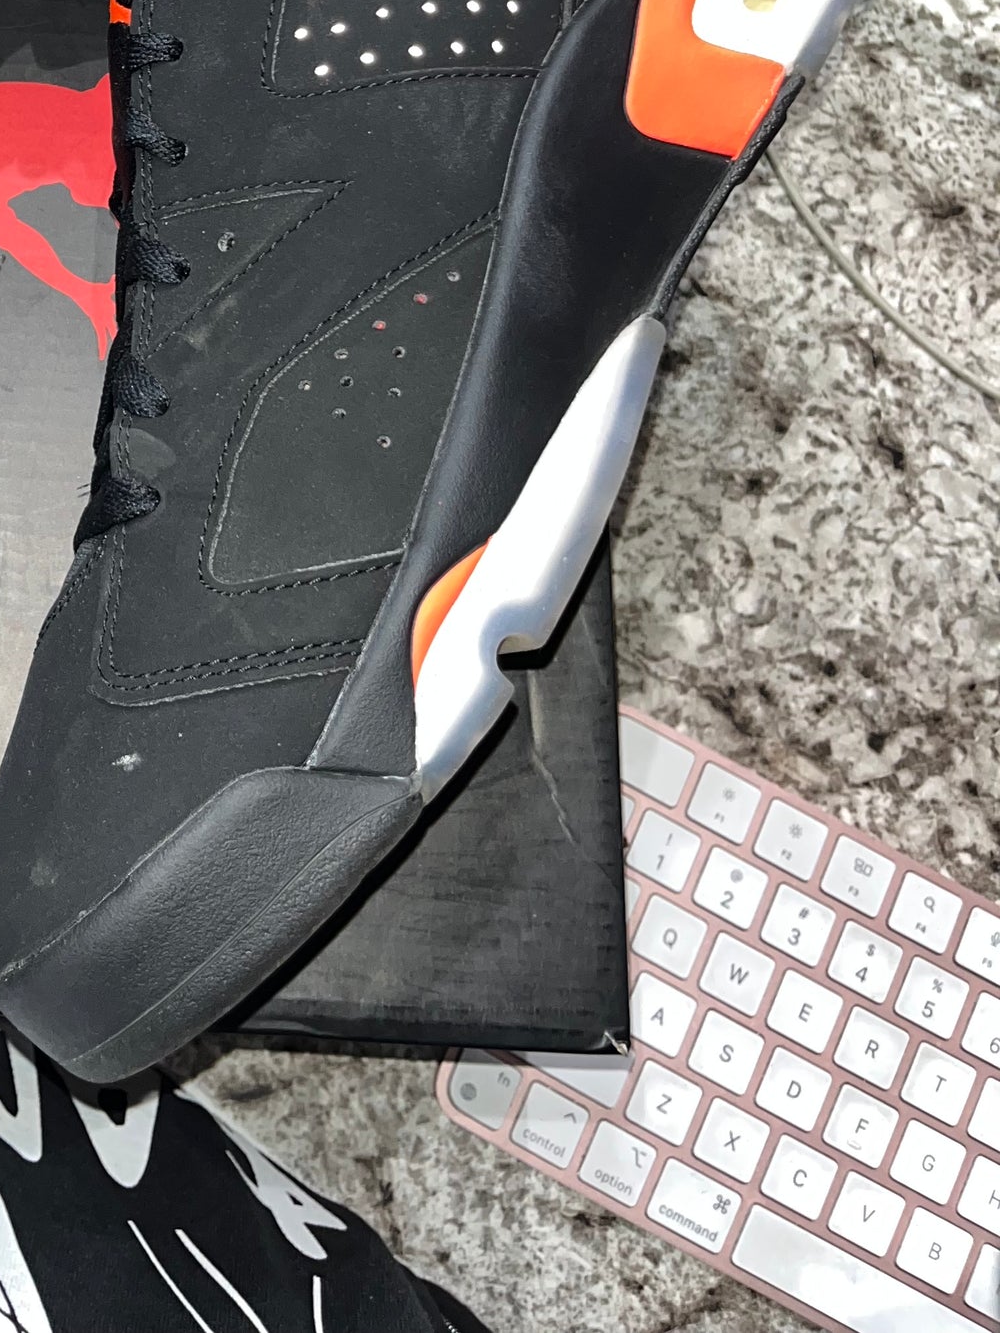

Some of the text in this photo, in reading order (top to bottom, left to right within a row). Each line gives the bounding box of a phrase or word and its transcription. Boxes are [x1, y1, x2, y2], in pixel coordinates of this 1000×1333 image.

[714, 812, 725, 823] F1
[656, 854, 665, 871] 1
[780, 848, 793, 861] F2
[720, 891, 734, 909] 2
[847, 885, 860, 897] F3
[787, 927, 802, 946] 3
[915, 922, 927, 934] F4
[662, 928, 678, 949] Q
[729, 963, 750, 985] W
[855, 966, 868, 983] 4
[650, 1007, 664, 1027] A
[798, 1002, 813, 1023] E
[921, 1000, 936, 1019] 5
[718, 1044, 735, 1063] S
[864, 1038, 880, 1059] R
[989, 1037, 1000, 1054] 6
[497, 1072, 511, 1088] fn
[786, 1079, 802, 1099] D
[935, 1074, 947, 1093] T
[656, 1093, 673, 1115] Z
[855, 1118, 869, 1136] F
[521, 1126, 567, 1159] control
[723, 1130, 741, 1152] X
[921, 1154, 936, 1172] G
[593, 1165, 634, 1198] option
[792, 1168, 808, 1188] C
[862, 1204, 876, 1223] V
[658, 1203, 719, 1244] command
[928, 1241, 943, 1261] B
